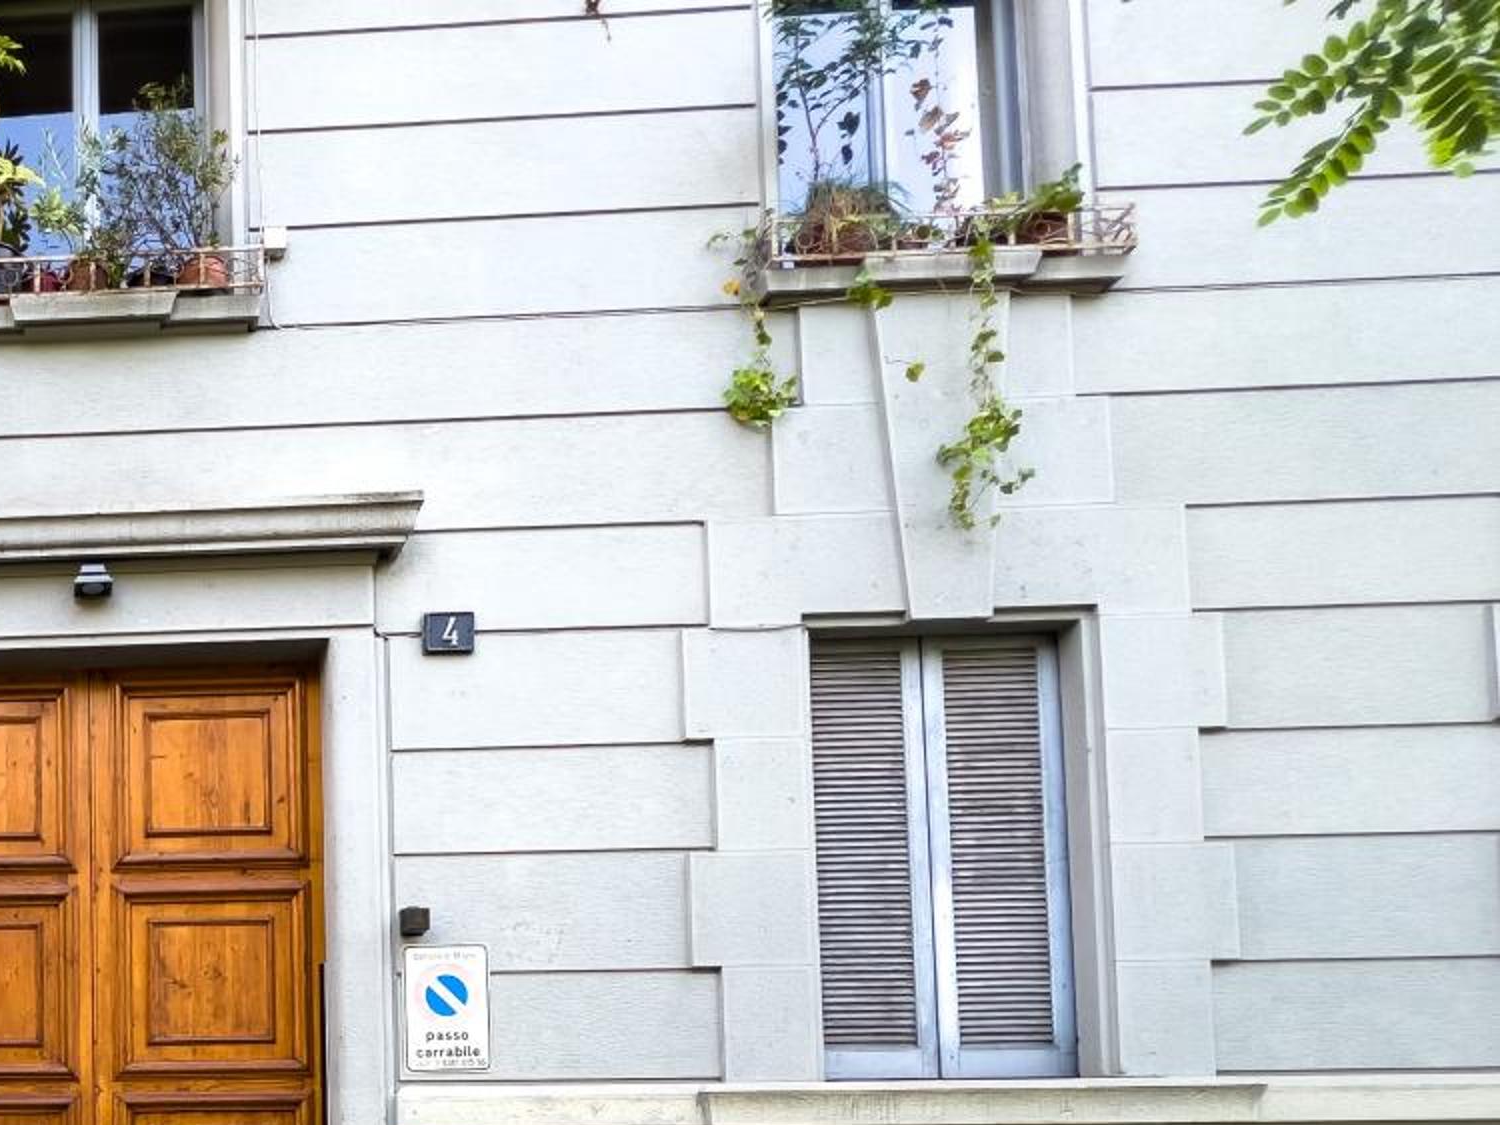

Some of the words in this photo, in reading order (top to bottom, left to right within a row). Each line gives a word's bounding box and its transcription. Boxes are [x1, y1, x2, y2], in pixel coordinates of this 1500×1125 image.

[442, 616, 459, 646] 4
[425, 1031, 469, 1043] passo
[416, 1046, 481, 1059] carrabile
